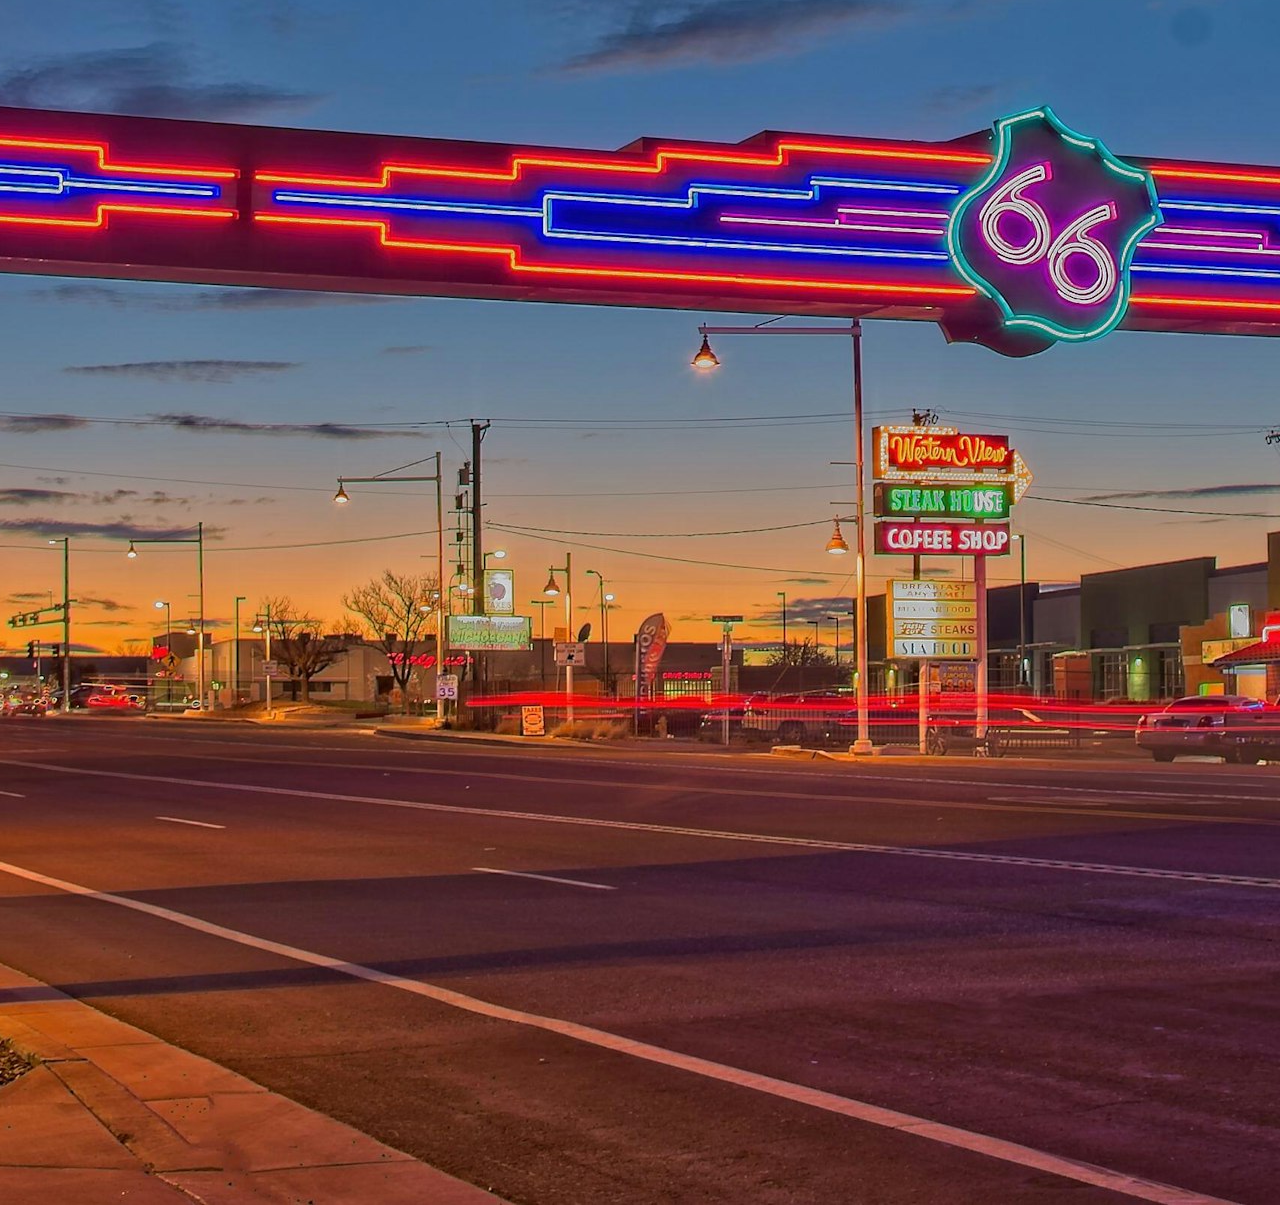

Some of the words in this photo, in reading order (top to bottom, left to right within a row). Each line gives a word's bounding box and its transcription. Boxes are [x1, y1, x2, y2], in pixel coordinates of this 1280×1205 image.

[978, 161, 1118, 306] 66
[891, 436, 967, 466] Western
[959, 436, 1007, 464] View
[891, 489, 945, 512] STEAK
[950, 490, 1004, 513] HOUSE
[887, 528, 952, 549] COFFEE
[957, 530, 1008, 550] SHOP
[902, 583, 967, 591] BREAKFAST
[931, 625, 975, 634] STEAKS
[902, 643, 927, 654] SEA
[933, 643, 971, 654] FOOD
[439, 687, 455, 696] 35
